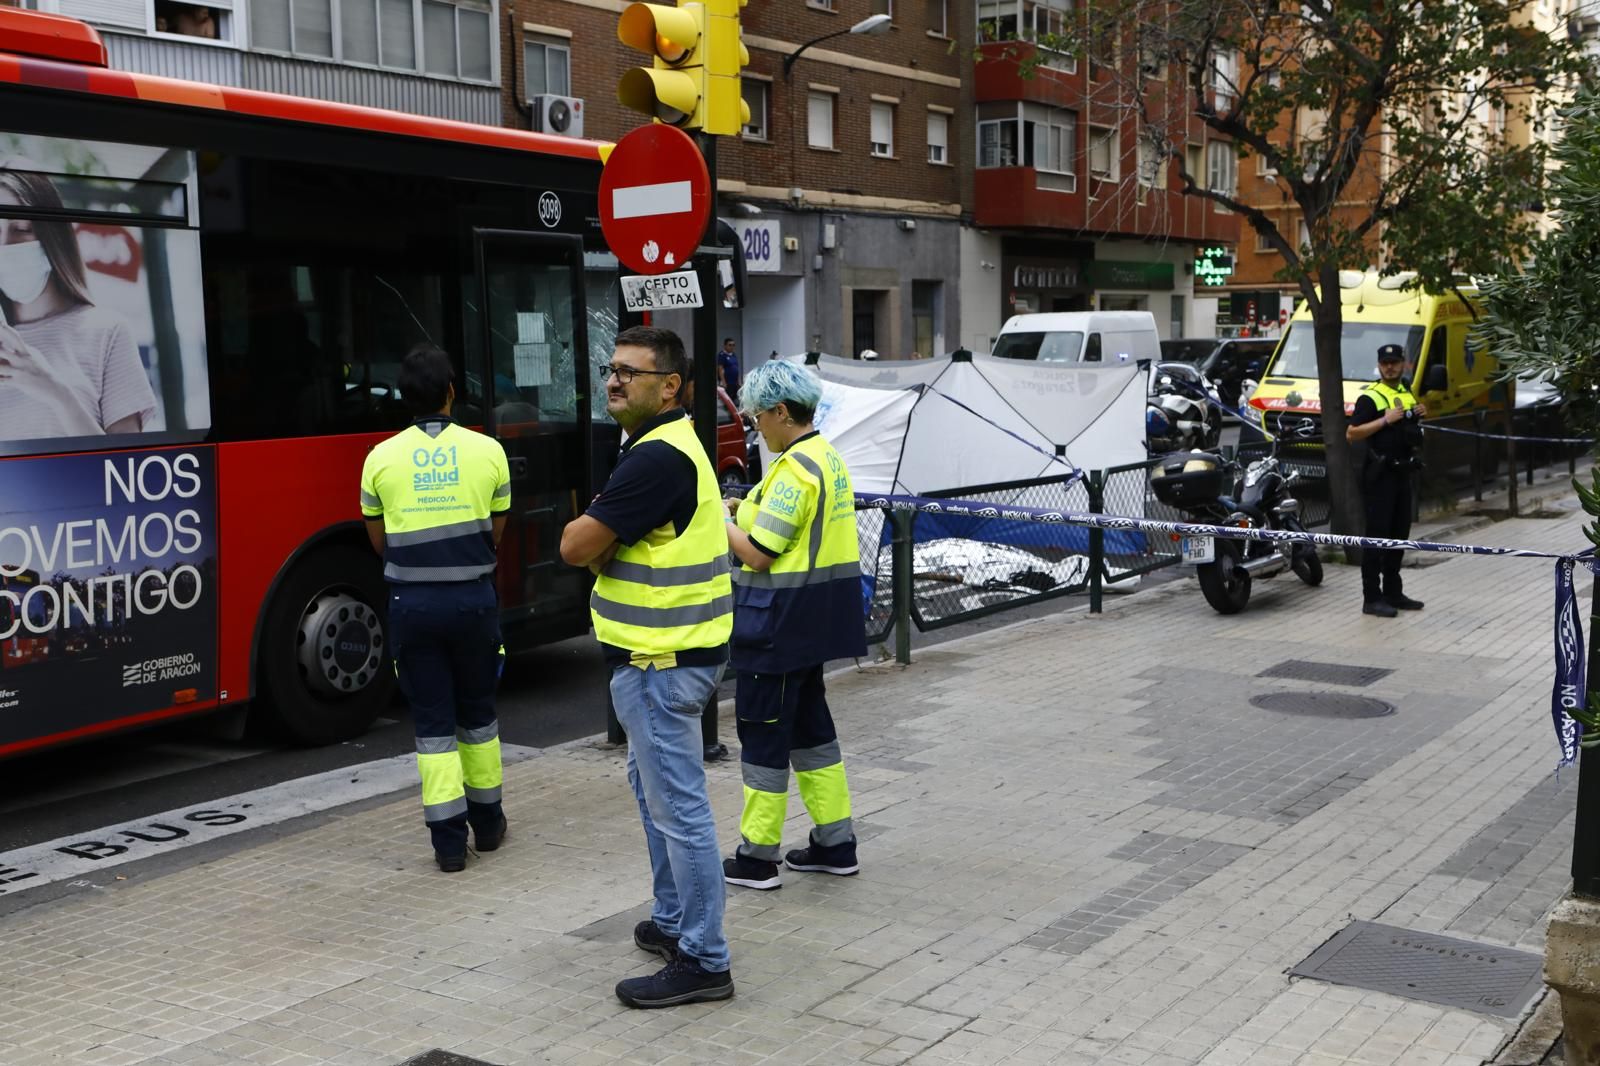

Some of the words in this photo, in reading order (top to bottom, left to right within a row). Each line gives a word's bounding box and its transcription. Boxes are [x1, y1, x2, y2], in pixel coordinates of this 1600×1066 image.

[541, 198, 559, 220] 3098
[744, 227, 770, 260] 208
[628, 276, 689, 290] CEPTO
[668, 293, 697, 304] TAXI
[413, 446, 457, 468] 061
[104, 453, 201, 506] NOS
[413, 467, 459, 484] salud
[774, 481, 802, 505] 061
[143, 653, 194, 672] GOBIERNO
[143, 672, 156, 683] DE
[159, 662, 201, 681] ARAGON
[1561, 684, 1577, 708] NO
